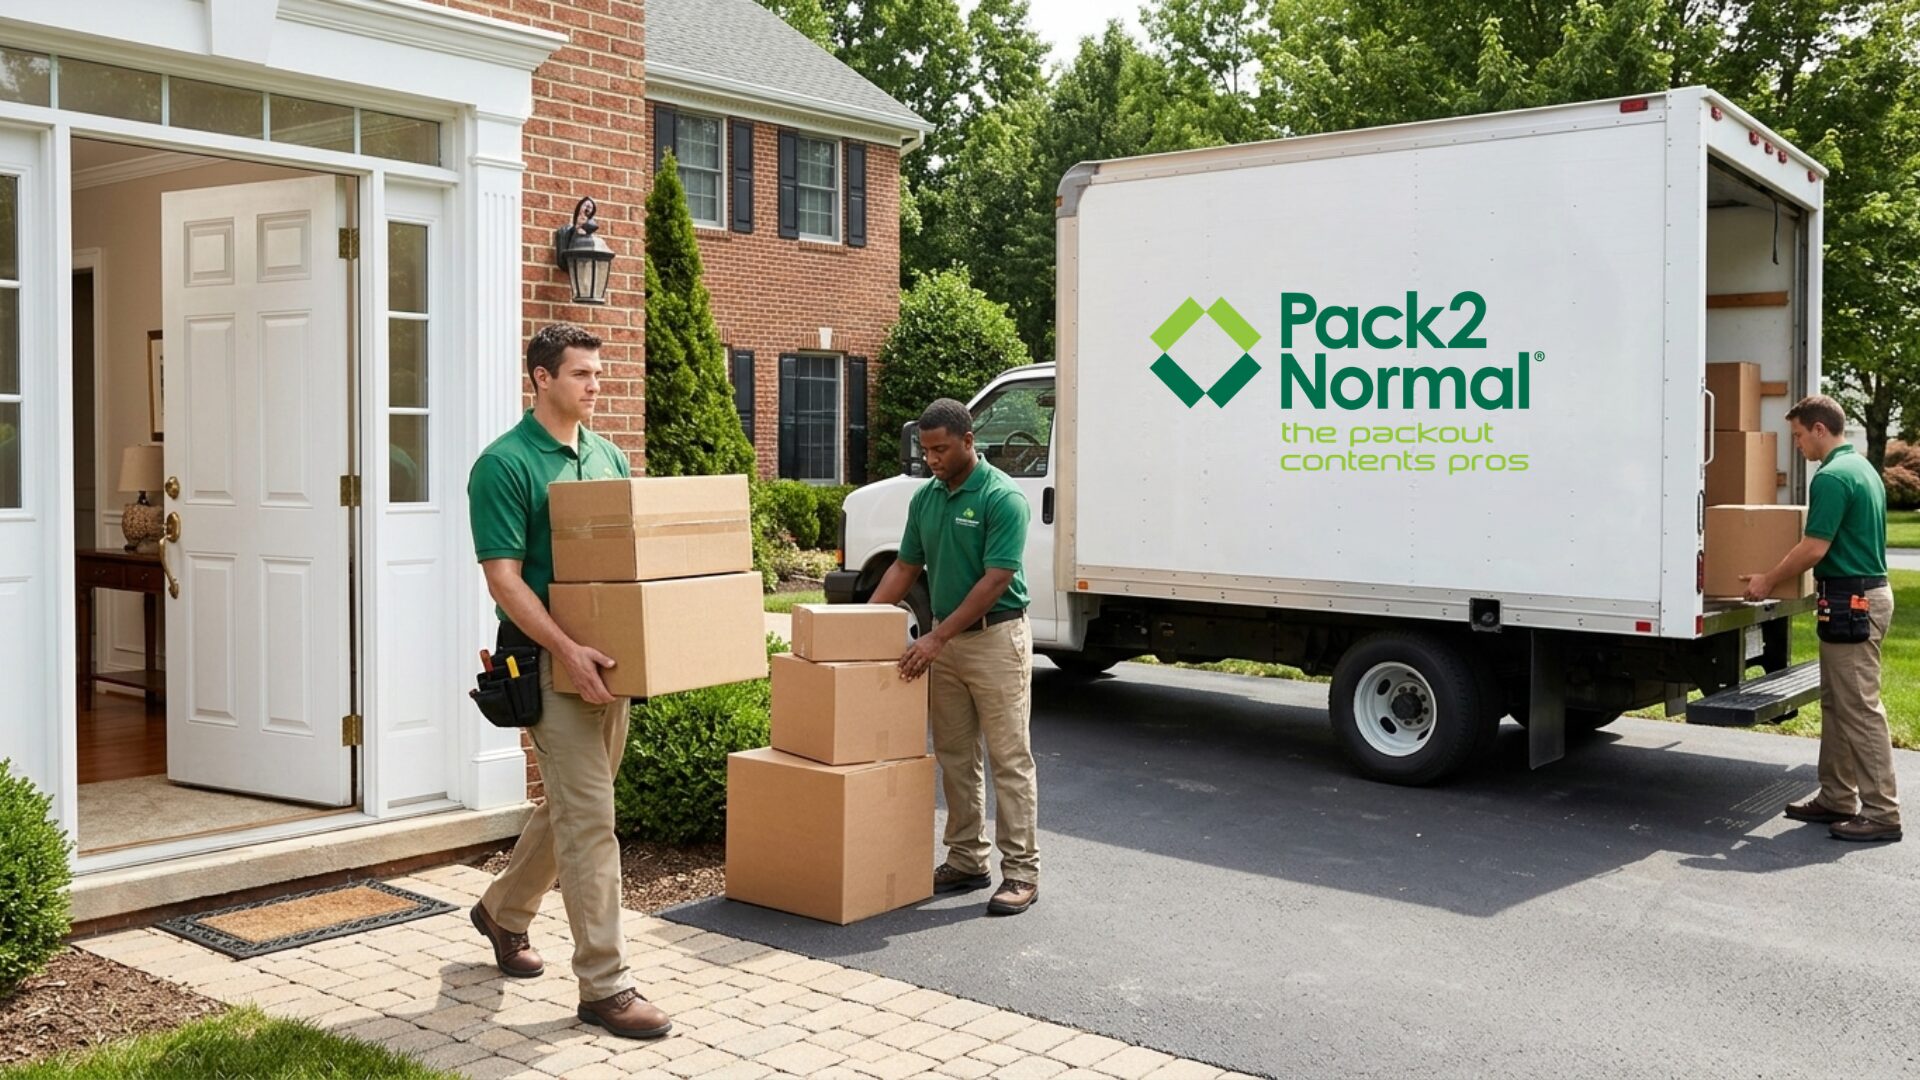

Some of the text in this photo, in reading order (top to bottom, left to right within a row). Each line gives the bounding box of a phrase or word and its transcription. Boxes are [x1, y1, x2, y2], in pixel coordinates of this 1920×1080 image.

[1281, 291, 1487, 350] Pack2
[1281, 422, 1494, 447] the packout
[1280, 450, 1530, 476] contents pros
